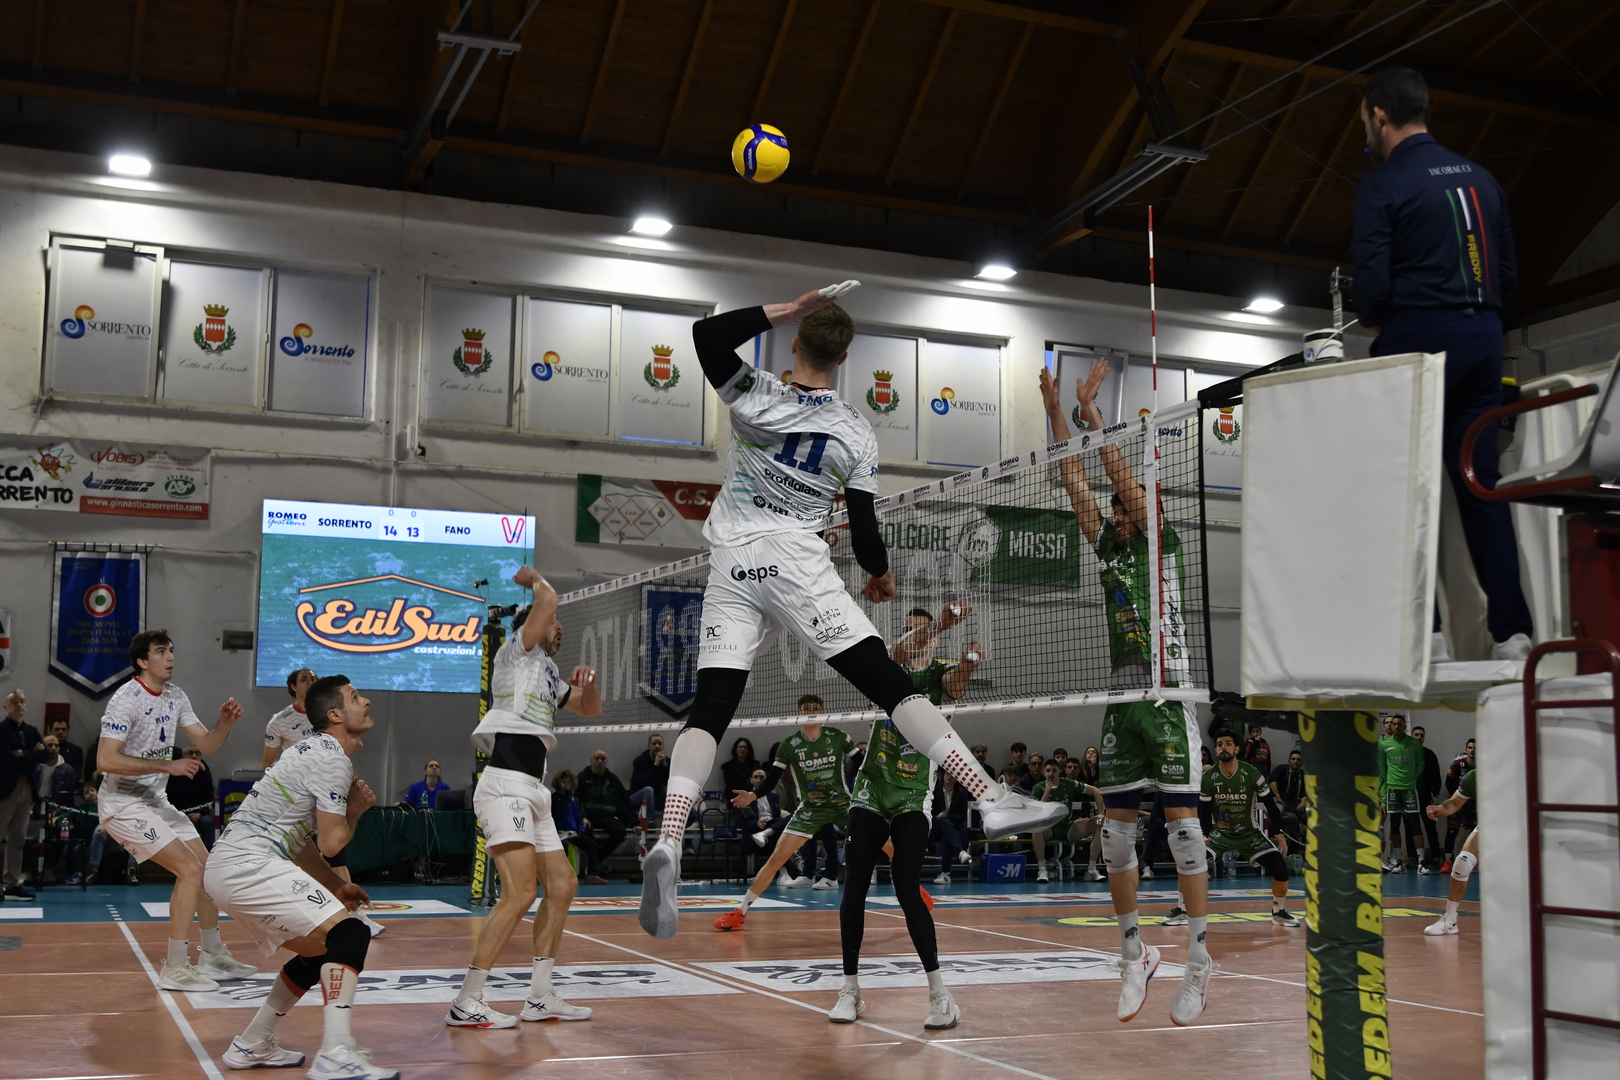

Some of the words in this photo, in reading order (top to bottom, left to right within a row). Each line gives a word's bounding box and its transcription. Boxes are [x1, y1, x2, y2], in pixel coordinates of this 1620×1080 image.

[1467, 234, 1482, 283] FREDDY
[87, 320, 151, 336] SORRENTO
[213, 358, 248, 373] Sorrento
[554, 365, 608, 379] SORRENTO
[798, 395, 832, 406] FANO
[950, 400, 996, 413] SORRENTO
[1102, 422, 1127, 434] ROMEO
[1046, 440, 1069, 452] ROMEO
[97, 446, 138, 465] VOBIS
[773, 432, 830, 476] 11
[999, 456, 1019, 467] ROMEO
[953, 472, 972, 481] ROMEO
[674, 487, 719, 506] C.S.
[86, 498, 203, 512] www.ginnasticasorrento.com
[268, 511, 307, 520] ROMEO
[388, 509, 394, 517] 0
[411, 510, 417, 518] 0
[318, 518, 372, 529] SORRENTO
[444, 525, 471, 535] FANO
[383, 525, 397, 536] 14
[406, 526, 419, 538] 13
[1009, 530, 1067, 560] MASSA
[747, 564, 779, 583] sps
[820, 612, 842, 624] SYSTEM
[413, 645, 477, 656] costruzioni
[481, 634, 490, 691] BANCA
[799, 755, 837, 767] ROMEO
[1214, 793, 1247, 801] ROMEO
[1304, 774, 1320, 934] BANCA
[1354, 775, 1384, 937] BANCA
